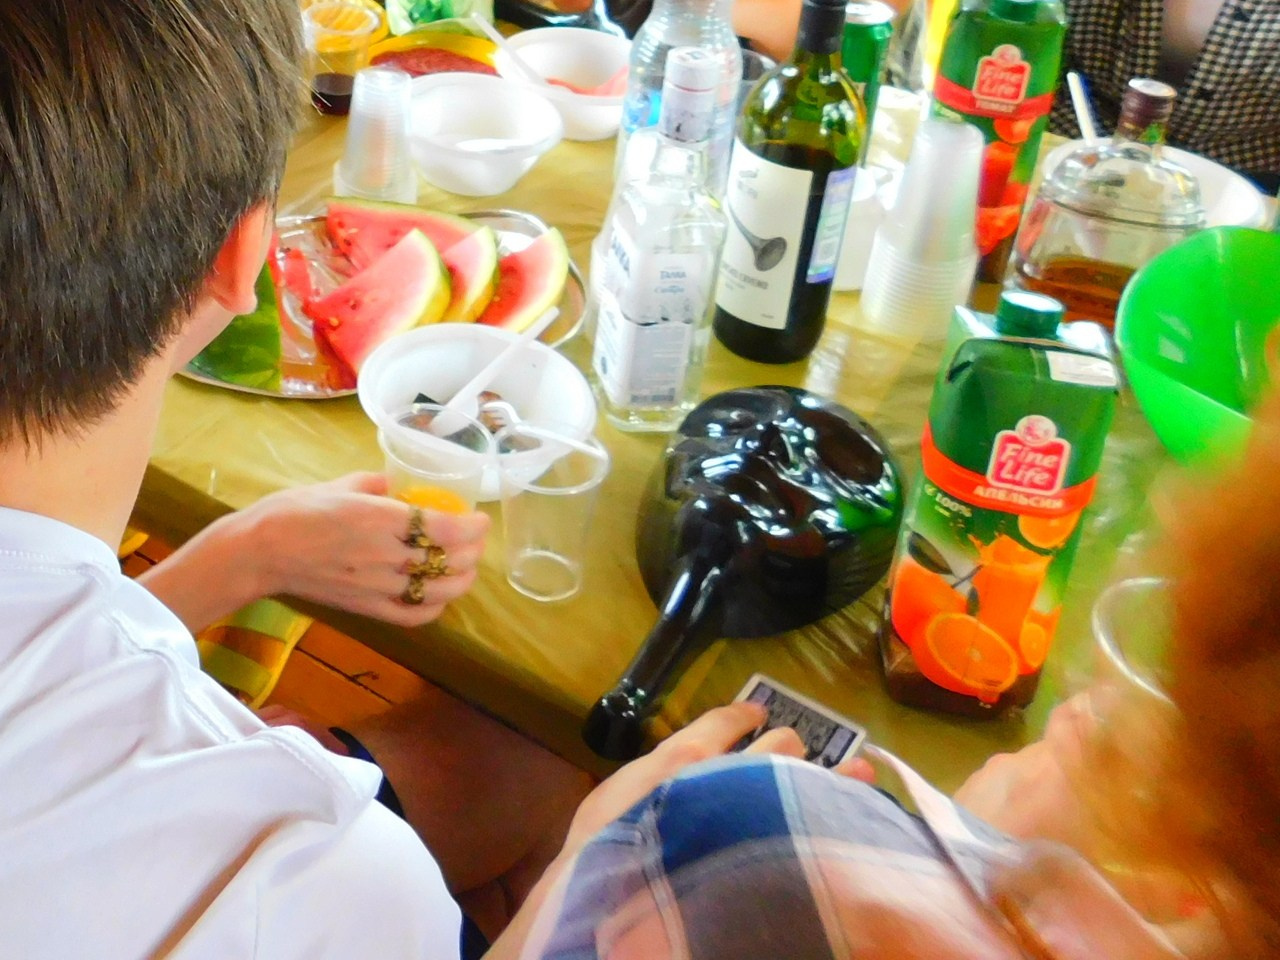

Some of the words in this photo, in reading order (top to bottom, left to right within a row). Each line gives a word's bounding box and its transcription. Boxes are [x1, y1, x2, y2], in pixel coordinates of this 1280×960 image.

[982, 65, 1024, 83] Fine
[981, 79, 1019, 97] Life
[1000, 443, 1059, 468] Fine
[999, 461, 1051, 486] Life
[935, 492, 972, 517] 100%
[973, 486, 1064, 509] АПЕЛЬСИН
